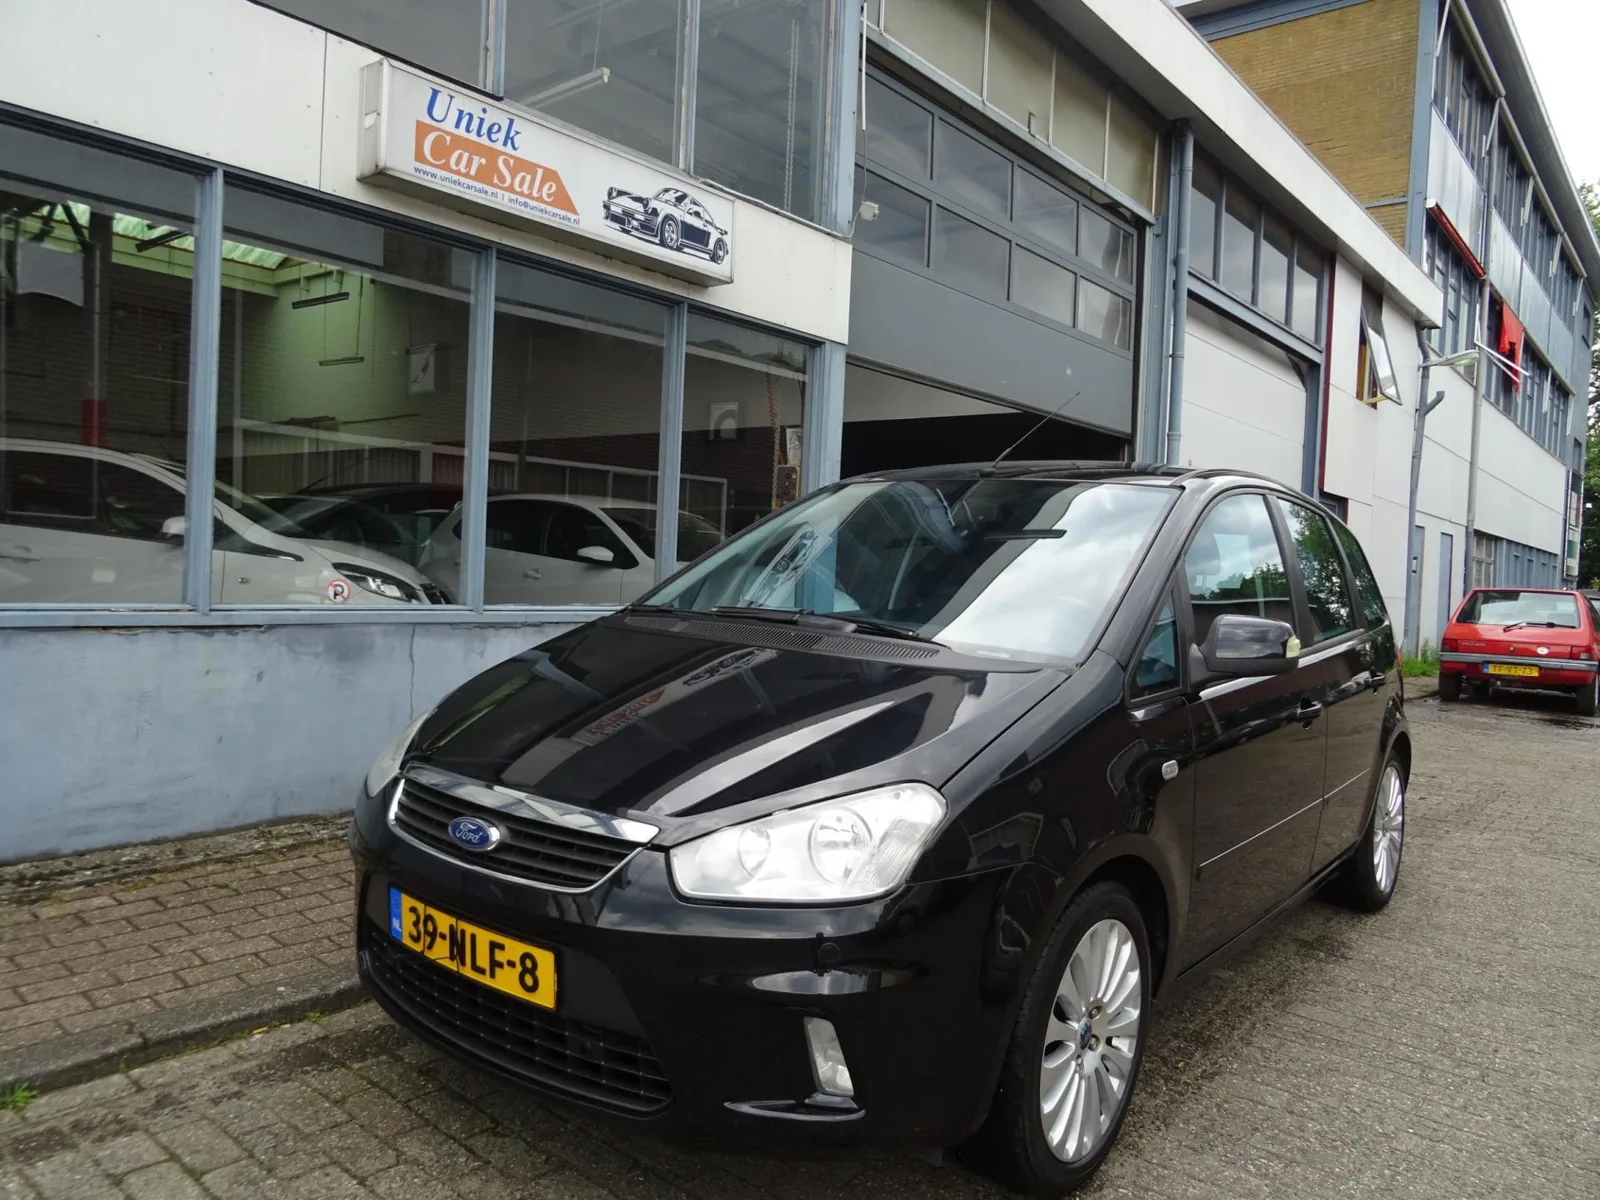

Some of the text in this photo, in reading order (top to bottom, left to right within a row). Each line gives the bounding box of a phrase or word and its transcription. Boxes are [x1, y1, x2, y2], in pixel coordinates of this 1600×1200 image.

[426, 86, 522, 151] Uniek
[413, 166, 499, 199] www.uniekcarsale.nl
[507, 197, 580, 226] info@uniekcarsale.nl
[423, 131, 558, 201] Car Sale
[455, 822, 483, 843] Ford
[408, 905, 539, 993] 39-NLF-8
